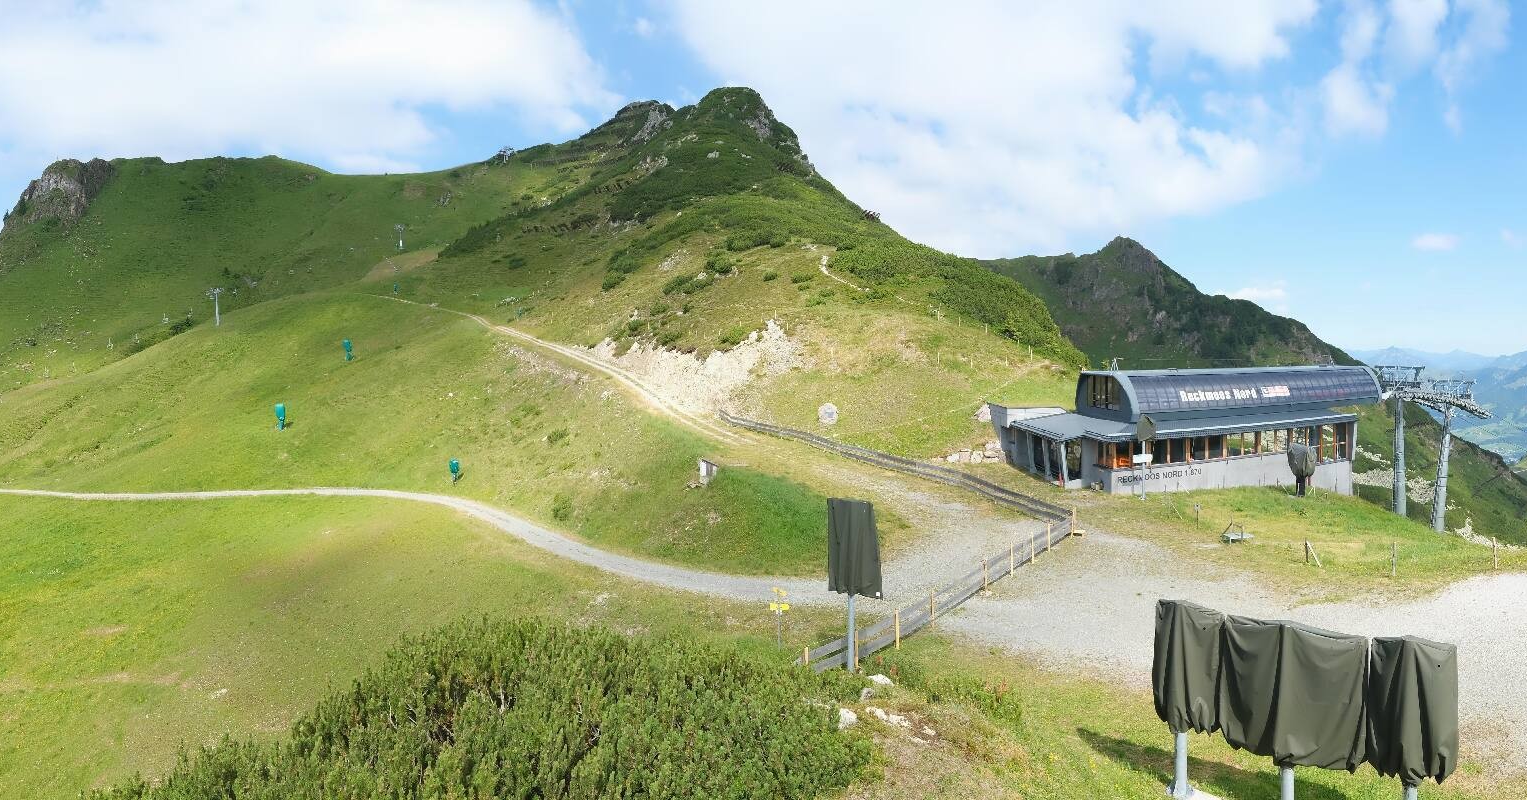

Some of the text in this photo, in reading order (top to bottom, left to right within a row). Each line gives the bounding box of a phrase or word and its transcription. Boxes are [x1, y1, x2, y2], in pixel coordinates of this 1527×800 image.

[1179, 390, 1231, 401] Reckmoos
[1233, 388, 1257, 399] Nord
[1117, 472, 1160, 483] RECKOOS
[1162, 470, 1183, 479] NORD
